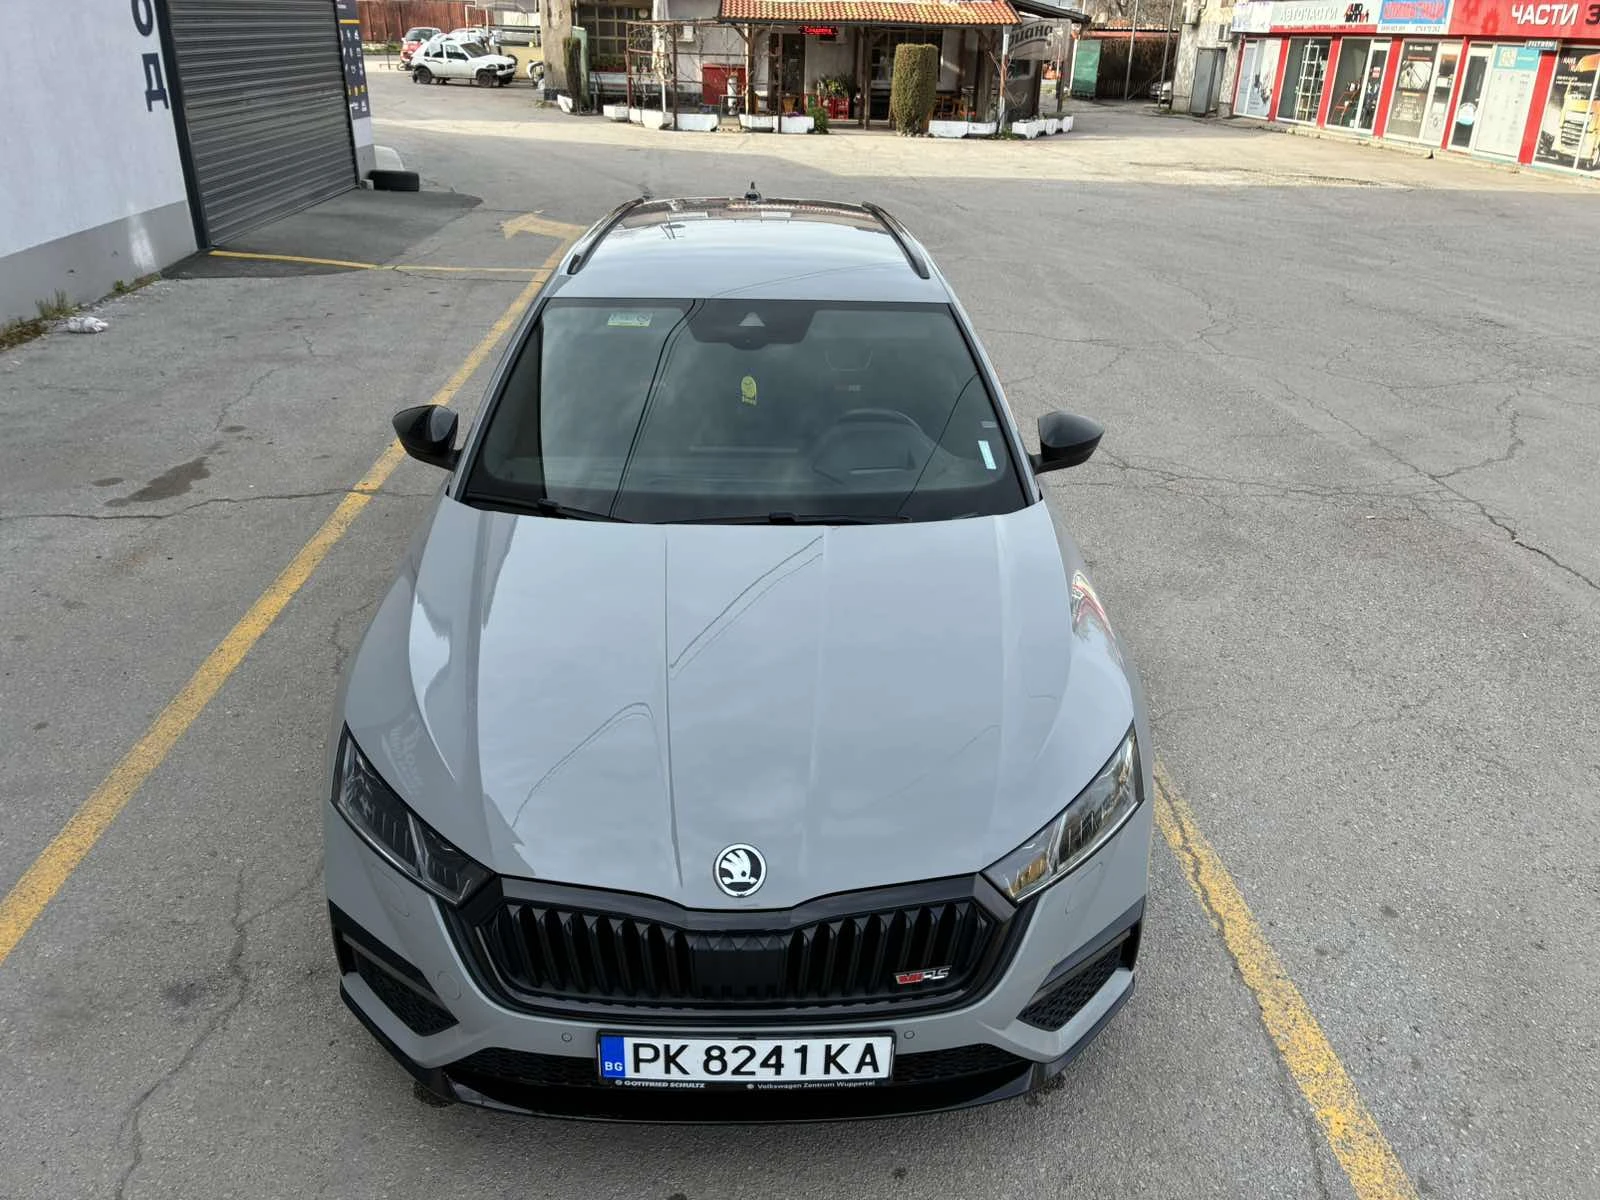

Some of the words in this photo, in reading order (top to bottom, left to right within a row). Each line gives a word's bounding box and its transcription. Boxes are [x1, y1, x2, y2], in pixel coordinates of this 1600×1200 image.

[1279, 7, 1338, 21] АВТОЧАСТИ
[1511, 3, 1579, 25] ЧАСТИ
[604, 1061, 623, 1072] BG
[632, 1043, 690, 1076] PK
[702, 1044, 810, 1076] 8241
[822, 1042, 881, 1074] KA
